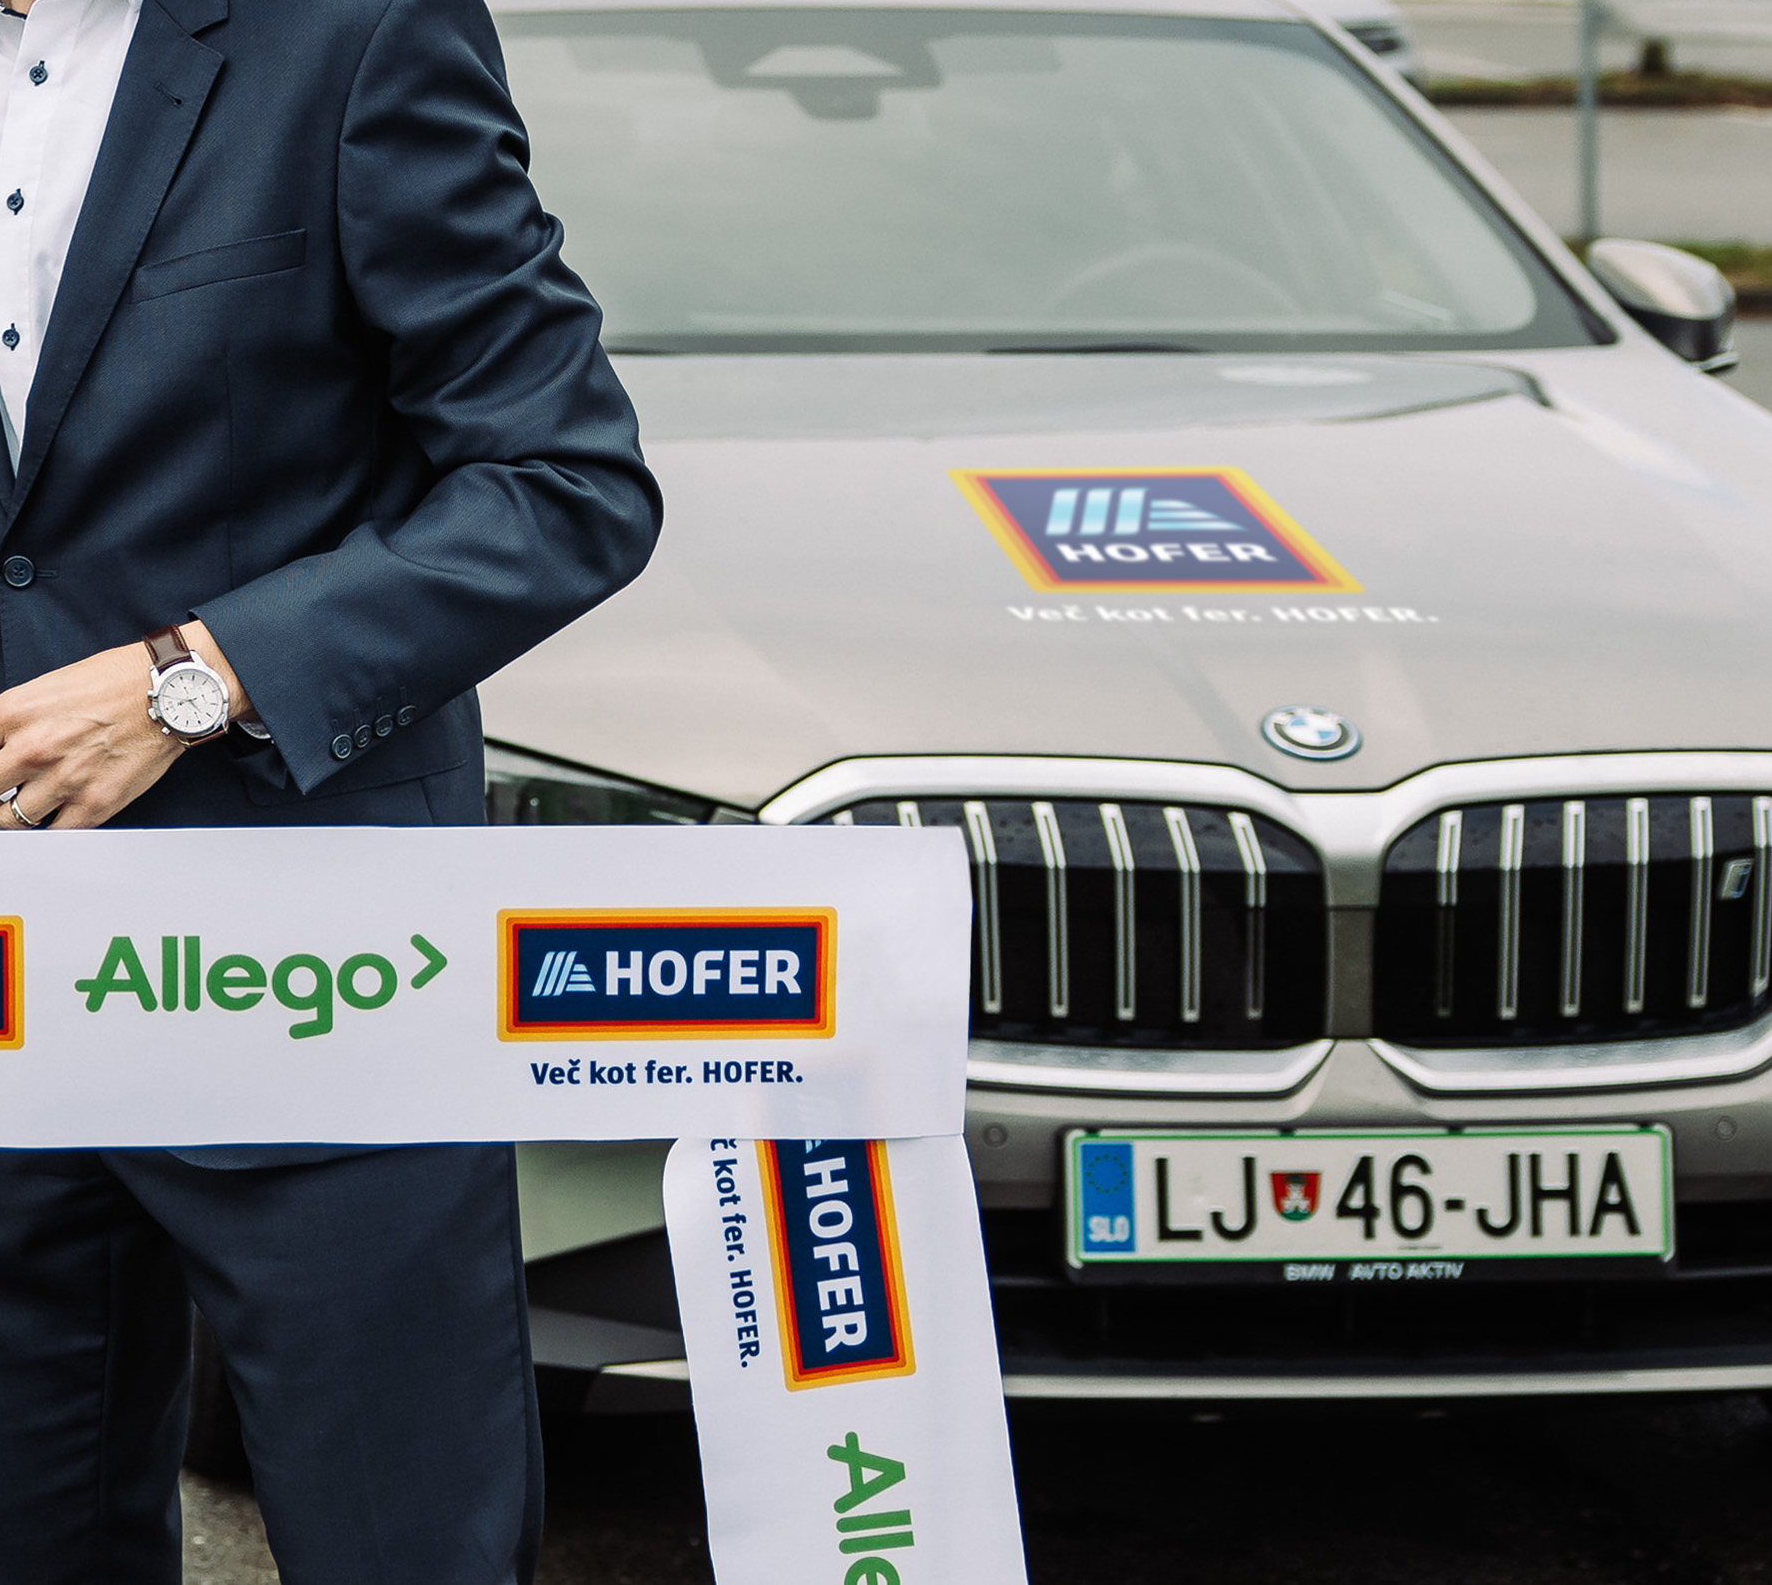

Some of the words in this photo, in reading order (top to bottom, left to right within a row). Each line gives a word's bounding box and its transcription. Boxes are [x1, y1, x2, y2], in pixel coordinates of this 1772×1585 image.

[1056, 543, 1279, 562] HOFER
[1096, 605, 1175, 622] kot
[1181, 605, 1263, 622] fer.
[1271, 606, 1439, 623] HOFER.
[74, 936, 398, 1041] Allego
[606, 949, 801, 996] HOFER
[531, 1057, 581, 1086] Več
[589, 1060, 638, 1086] kot
[645, 1059, 693, 1085] fer.
[702, 1060, 804, 1084] HOFER.
[713, 1158, 742, 1207] kot
[1155, 1156, 1257, 1243] LJ
[1336, 1151, 1642, 1240] 46-JHA
[721, 1212, 747, 1262] fer.
[1088, 1215, 1129, 1243] SLO
[804, 1156, 868, 1353] HOFER
[1284, 1263, 1335, 1281] BMW
[729, 1269, 761, 1368] HOFER.
